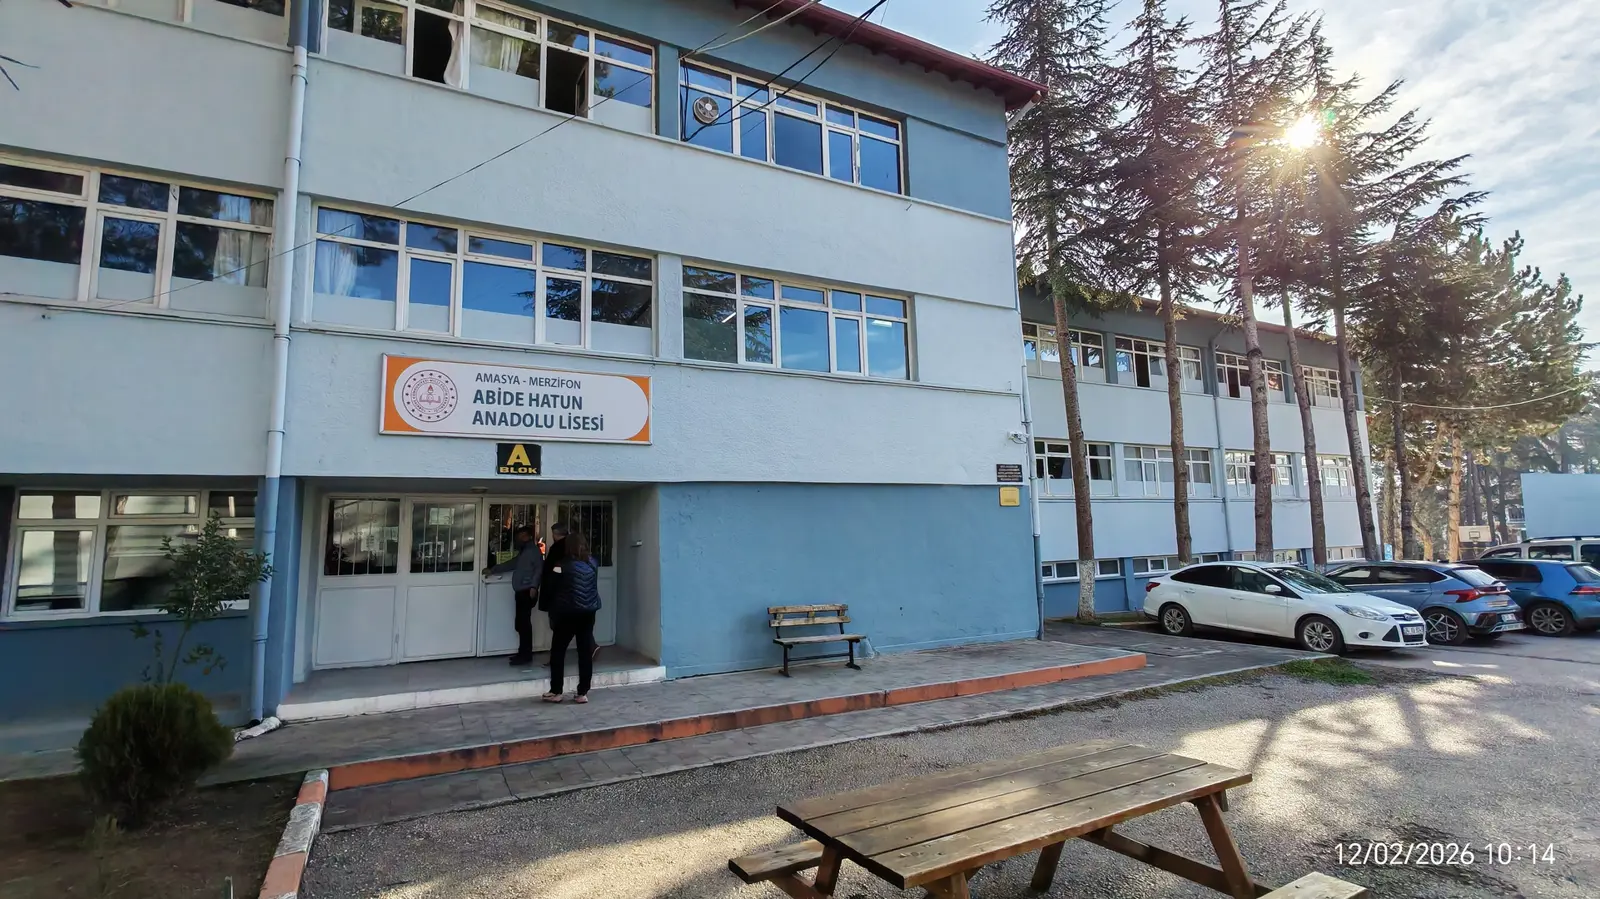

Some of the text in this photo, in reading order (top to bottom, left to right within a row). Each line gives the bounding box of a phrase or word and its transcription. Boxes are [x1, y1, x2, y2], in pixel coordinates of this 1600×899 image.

[475, 372, 520, 385] AMASYA
[529, 376, 581, 389] MERZİFON
[473, 387, 583, 410] ABİDE HATUN
[472, 410, 604, 431] ANADOLU LİSESİ
[506, 444, 531, 466] A
[500, 466, 538, 474] BLOK
